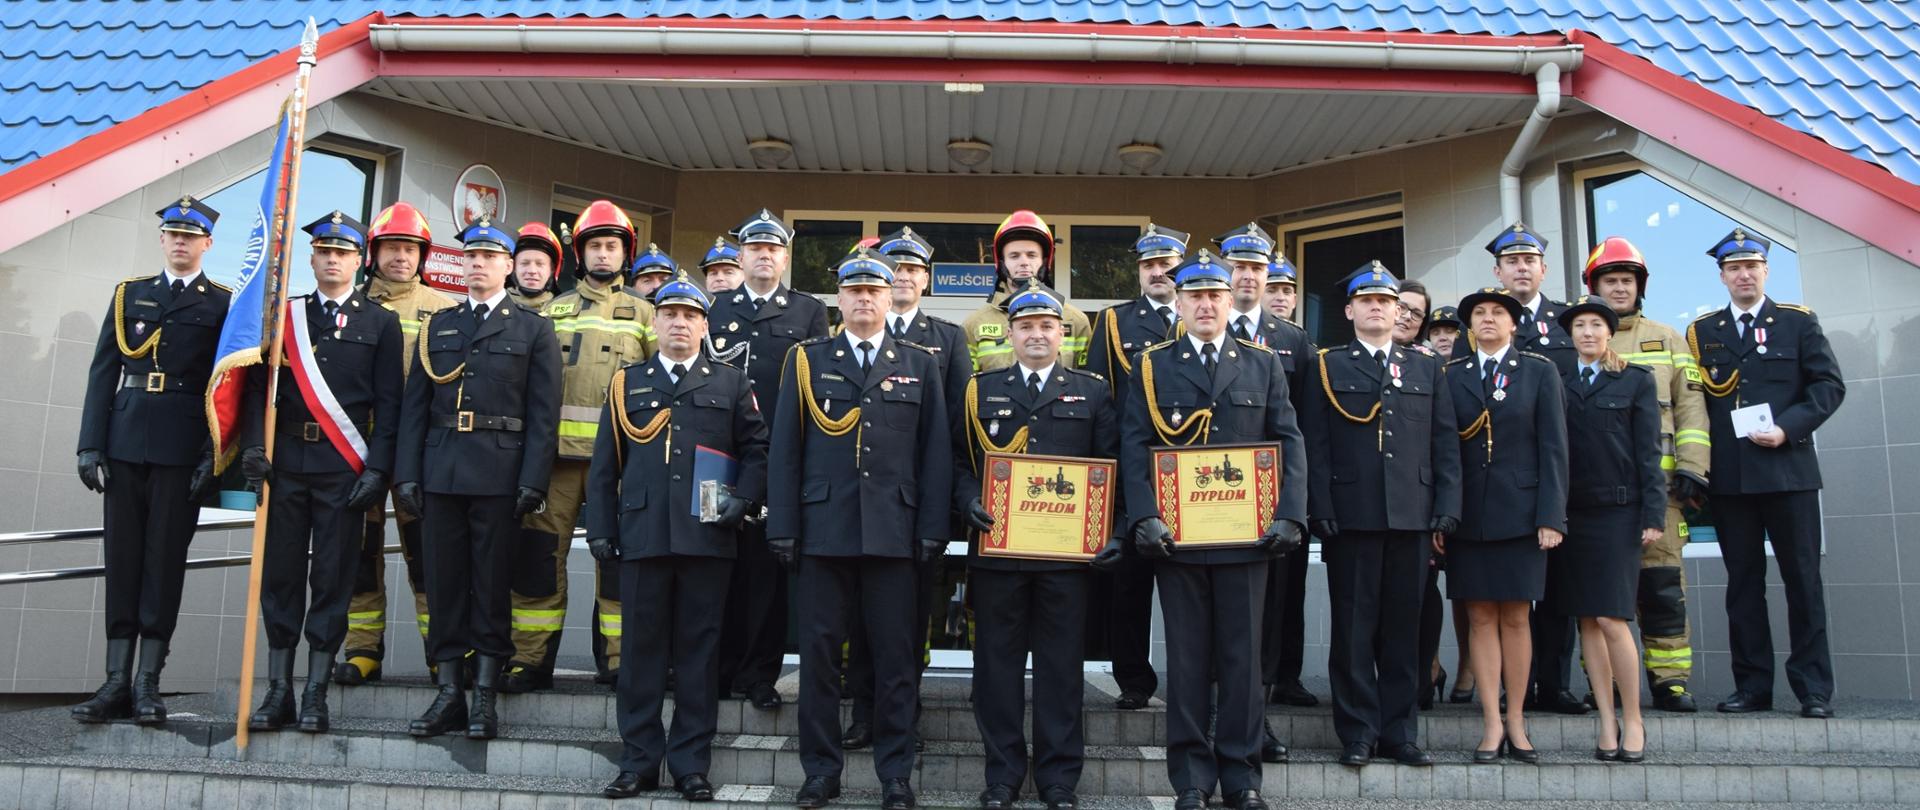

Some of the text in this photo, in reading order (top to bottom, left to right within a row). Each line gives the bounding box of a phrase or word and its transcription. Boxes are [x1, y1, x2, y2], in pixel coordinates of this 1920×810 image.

[937, 273, 994, 287] WEJŚCIE
[982, 325, 999, 334] PSP
[1190, 489, 1247, 502] DYPLOM
[1019, 500, 1076, 514] DYPLOM
